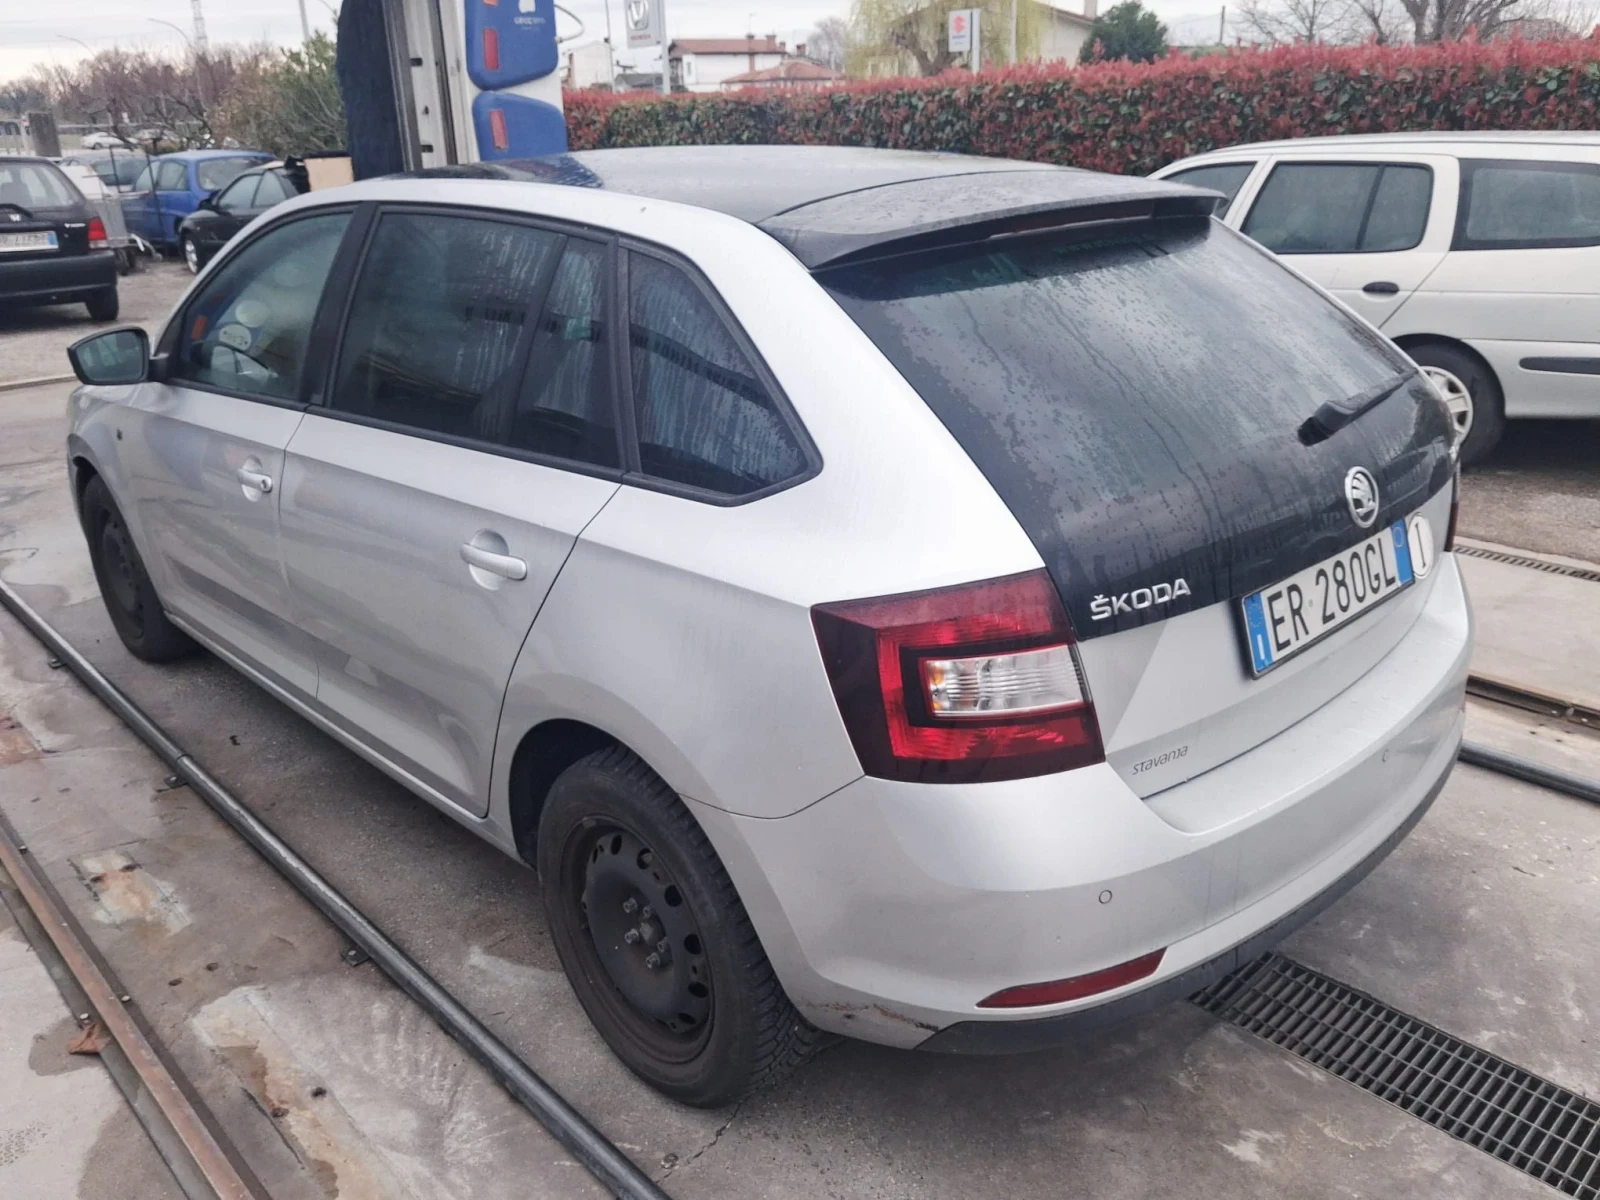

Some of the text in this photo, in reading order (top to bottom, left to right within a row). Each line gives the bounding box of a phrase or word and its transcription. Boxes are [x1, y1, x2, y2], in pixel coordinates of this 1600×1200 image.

[1090, 578, 1192, 620] ŠKODA
[1267, 538, 1396, 652] ER 280GL
